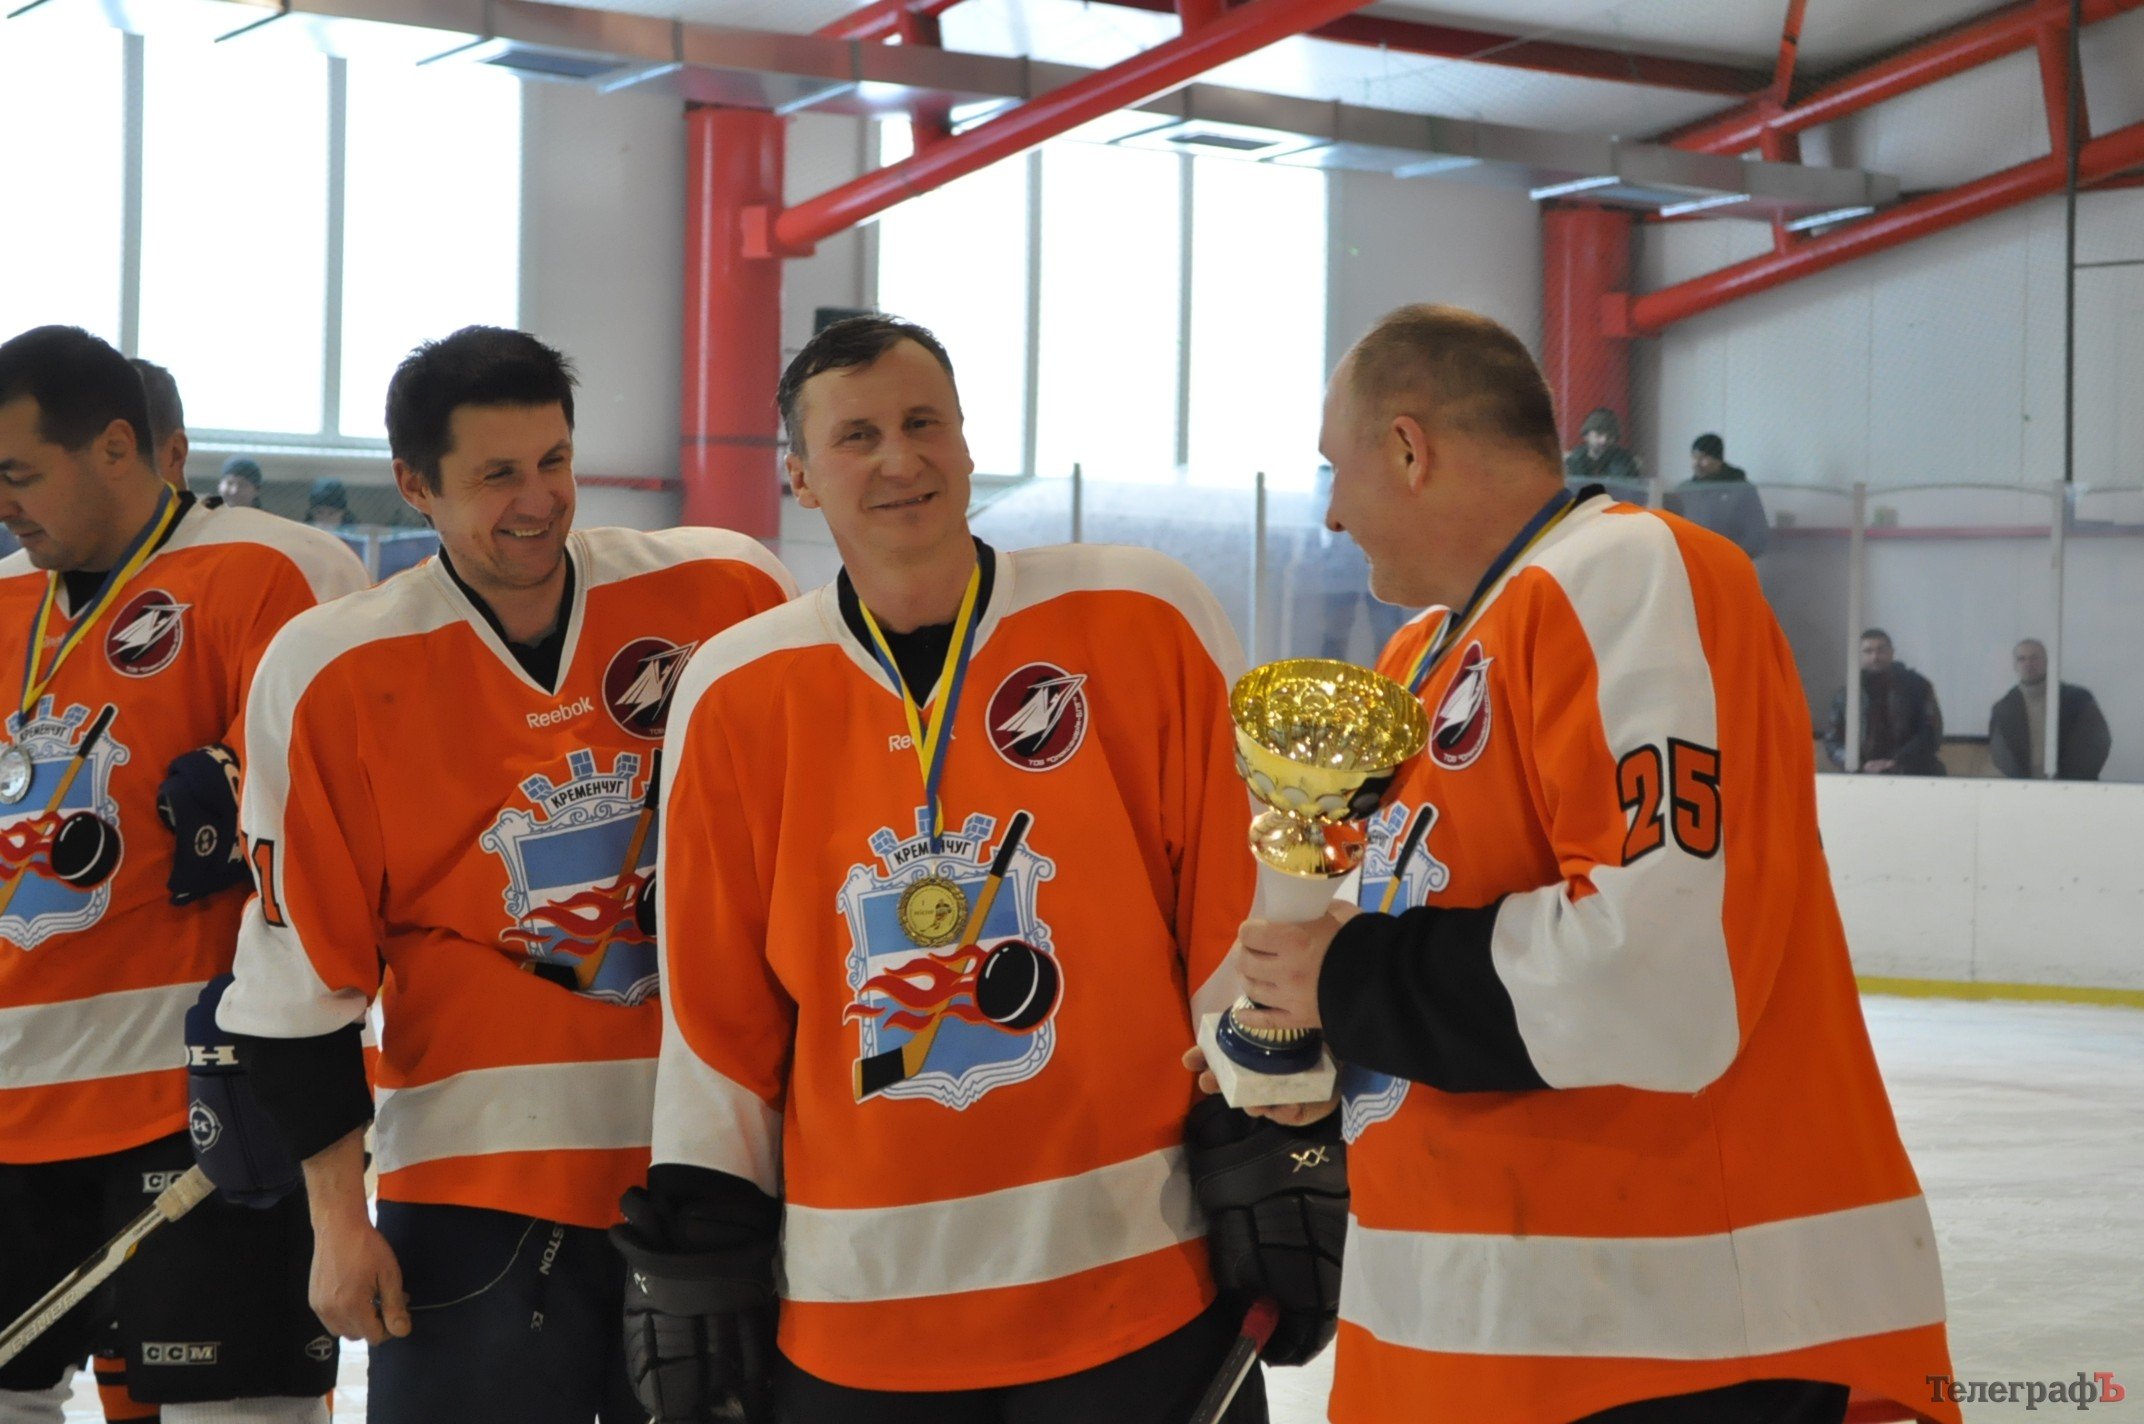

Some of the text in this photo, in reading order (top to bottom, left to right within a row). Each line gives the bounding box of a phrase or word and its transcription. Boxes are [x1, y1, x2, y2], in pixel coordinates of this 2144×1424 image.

[526, 697, 594, 729] Reebok
[551, 781, 624, 809] КРЕМЕНЧУГ
[1616, 736, 1721, 867] 25
[894, 842, 971, 866] КРЕМЧУГ
[241, 831, 287, 927] 1
[539, 1225, 564, 1275] STON
[144, 1344, 216, 1364] CCM
